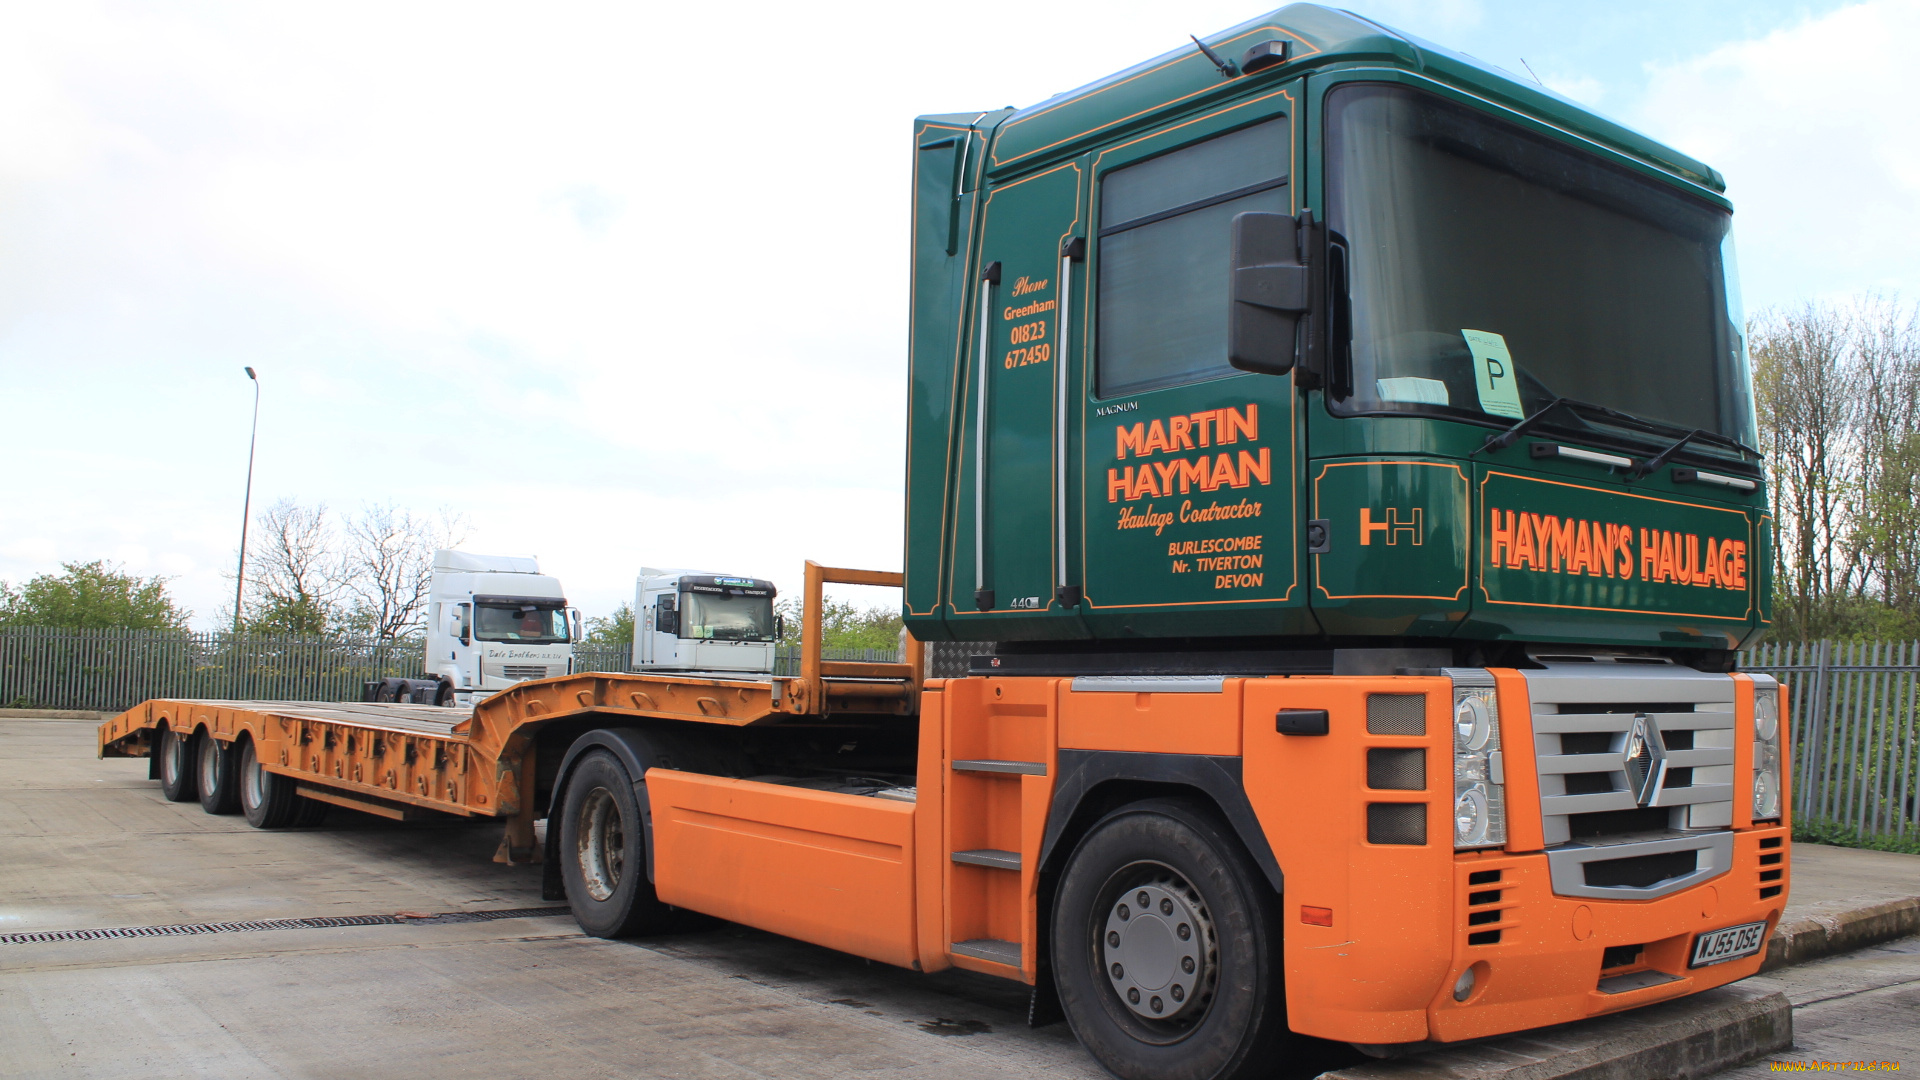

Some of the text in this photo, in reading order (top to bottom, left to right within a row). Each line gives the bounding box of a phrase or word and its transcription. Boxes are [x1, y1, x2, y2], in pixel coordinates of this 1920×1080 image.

[1012, 276, 1048, 297] Phone
[1004, 300, 1055, 320] Greenham
[1011, 320, 1046, 344] 01823
[1005, 343, 1050, 369] 672450
[1486, 357, 1504, 390] P
[1096, 401, 1139, 417] MAGNUM
[1116, 403, 1258, 460] MARTIN
[1107, 447, 1271, 502] HAYMAN
[1117, 498, 1262, 536] Haulage Contractor
[1168, 535, 1262, 556] BURLESCOMBE
[1491, 508, 1746, 590] HAYMAN'S HAULAGE
[1172, 554, 1263, 573] Nr. TIVERTON
[1215, 573, 1263, 589] DEVON
[1010, 598, 1032, 608] 440
[508, 650, 539, 658] Brothers
[1698, 925, 1761, 958] WJ55 DSE
